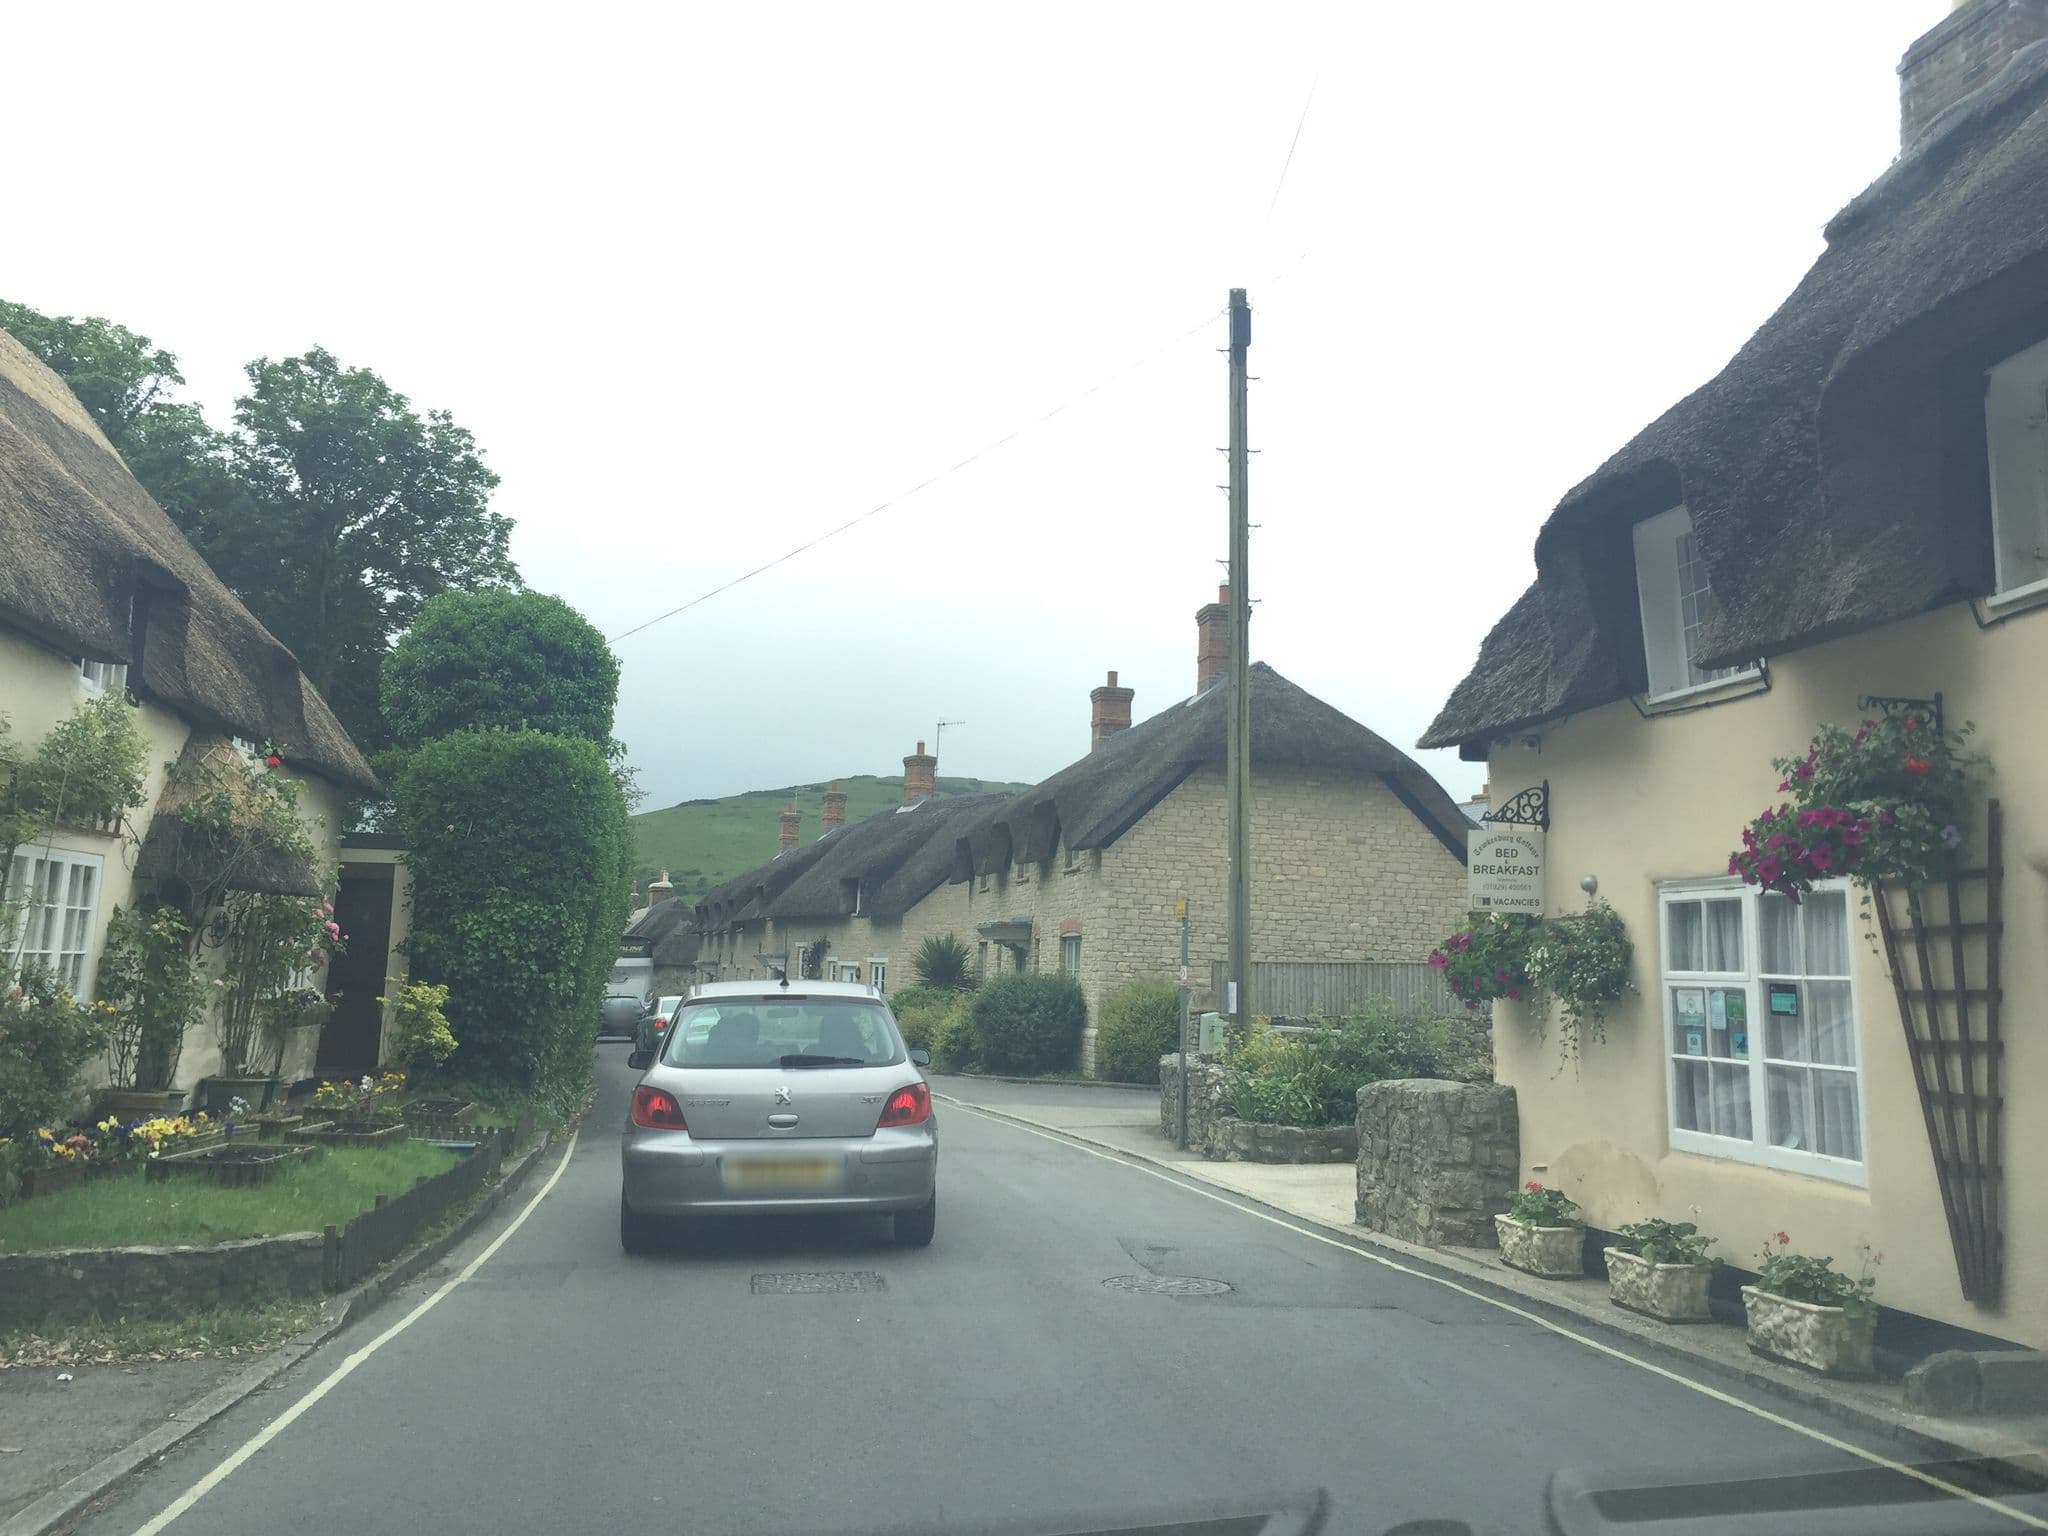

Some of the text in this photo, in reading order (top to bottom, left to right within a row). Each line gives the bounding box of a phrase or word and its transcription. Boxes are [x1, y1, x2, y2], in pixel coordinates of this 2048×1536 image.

[1495, 848, 1519, 858] BED
[1473, 864, 1540, 876] BREAKFAST
[1493, 898, 1540, 907] VACANCIES
